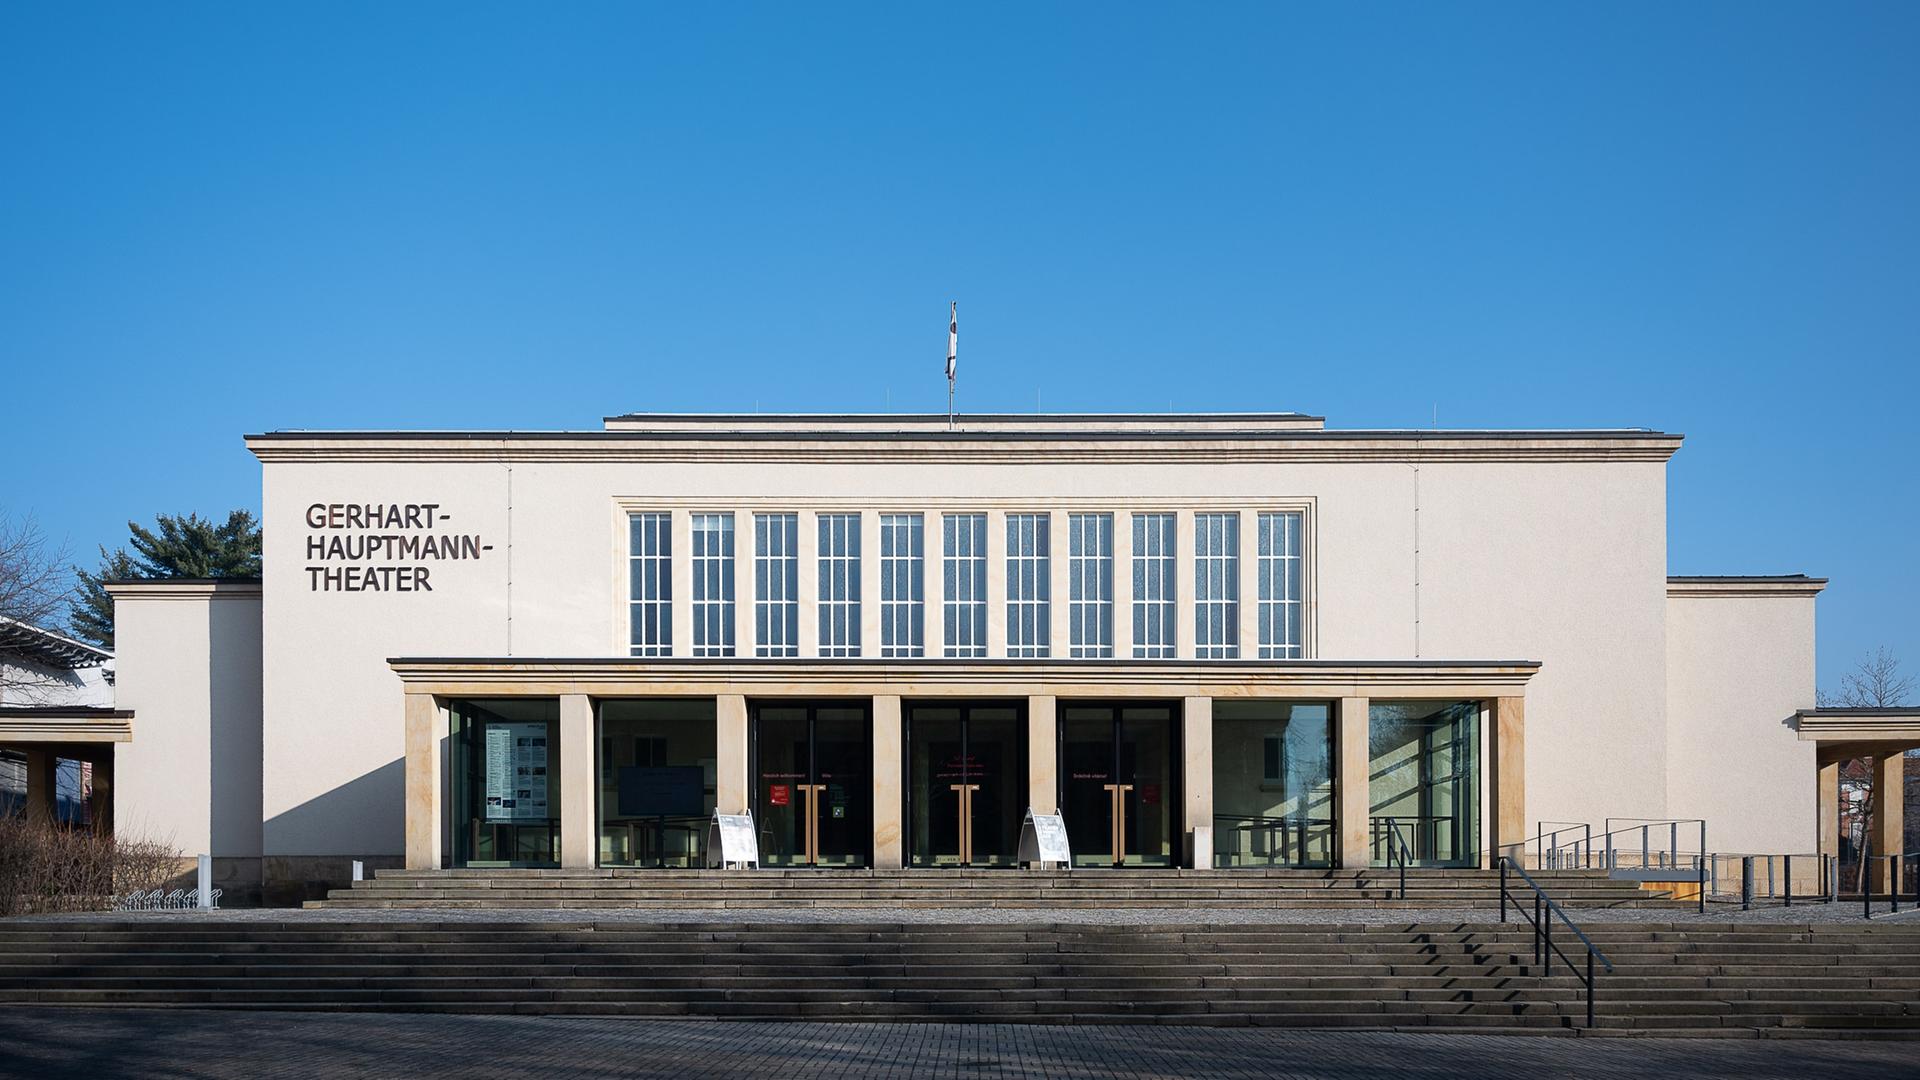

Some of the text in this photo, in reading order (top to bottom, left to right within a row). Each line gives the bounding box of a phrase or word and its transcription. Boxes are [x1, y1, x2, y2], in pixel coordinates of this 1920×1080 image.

[306, 503, 451, 529] GERHART-
[306, 535, 494, 560] HAUPTMANN-
[305, 566, 433, 592] THEATER
